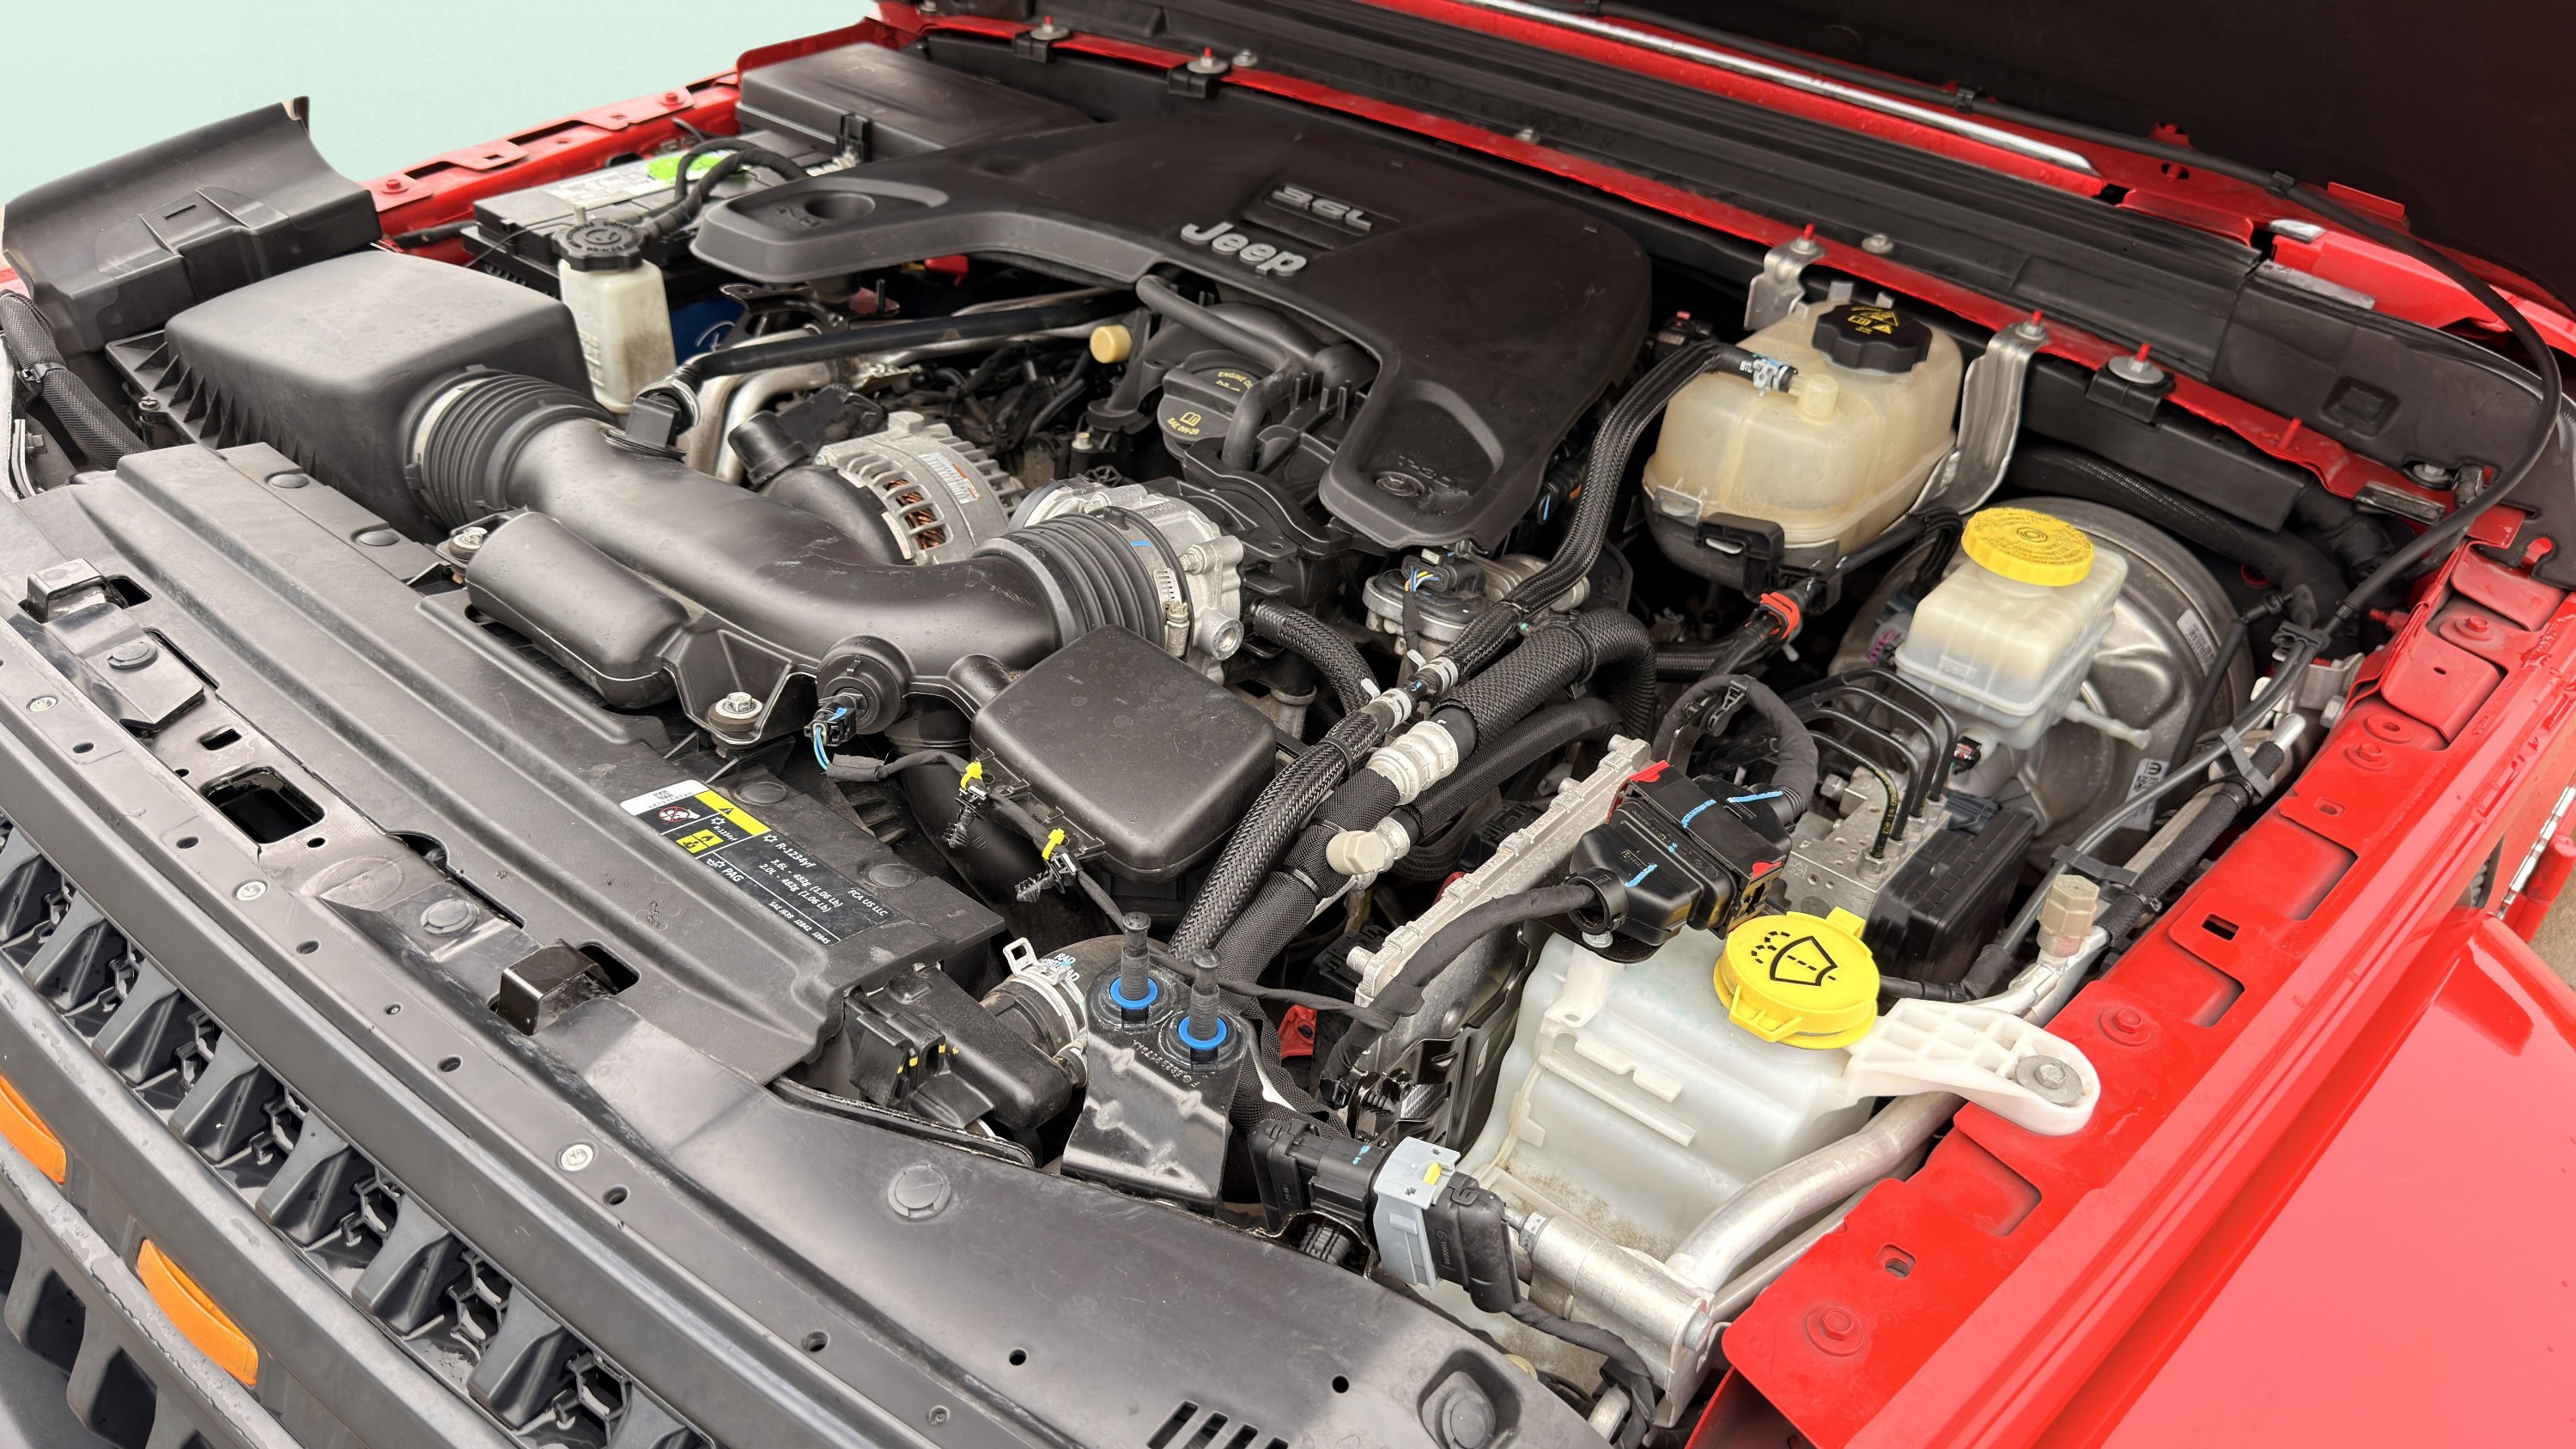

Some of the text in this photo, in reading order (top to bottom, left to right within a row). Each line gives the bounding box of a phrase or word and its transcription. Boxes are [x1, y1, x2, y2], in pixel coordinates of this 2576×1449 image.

[1180, 221, 1308, 277] Jeep
[1218, 371, 1246, 382] ENGINE
[1167, 417, 1180, 429] SAE
[713, 825, 738, 842] R-1234yf
[775, 843, 817, 868] R-1234yf
[722, 868, 744, 882] PAG
[770, 859, 787, 871] 3.6L
[793, 874, 811, 887] 482g
[810, 886, 830, 900] (1.06
[828, 898, 844, 908] Lb)
[759, 863, 776, 875] 2.0L
[781, 879, 799, 892] 482g
[798, 890, 820, 904] (1.06
[817, 903, 832, 913] Lb)
[769, 901, 781, 911] SAE
[848, 889, 889, 916] FCA US LLC
[1054, 953, 1077, 965] RAD
